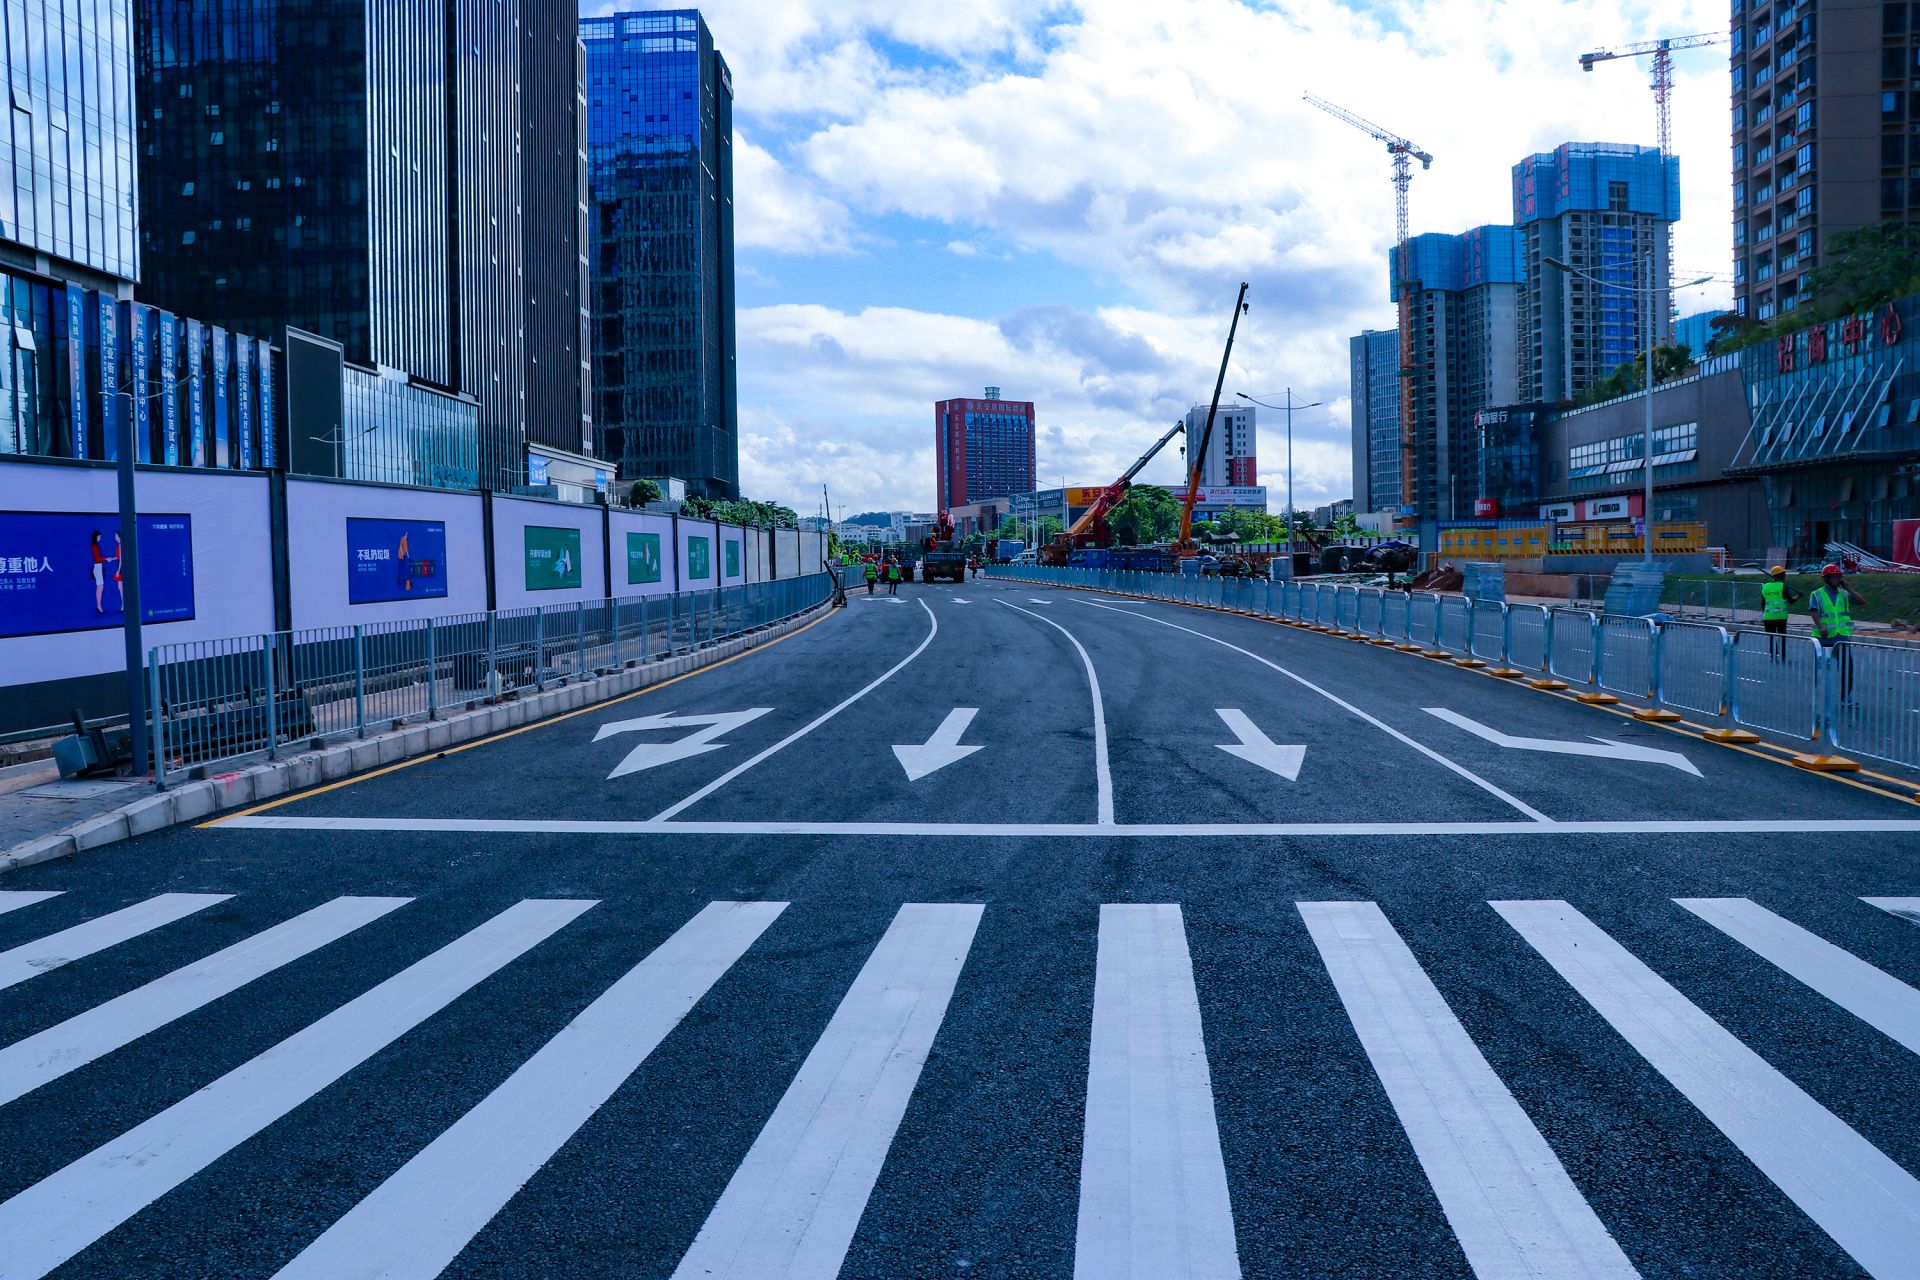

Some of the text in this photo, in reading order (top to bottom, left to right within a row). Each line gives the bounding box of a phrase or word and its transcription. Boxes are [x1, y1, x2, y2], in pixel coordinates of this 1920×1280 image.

[105, 304, 115, 389] 高端商业街区
[136, 313, 147, 422] 公共商务服务中心
[1776, 302, 1902, 374] 招商中心
[357, 548, 391, 561] 不乱扔垃圾
